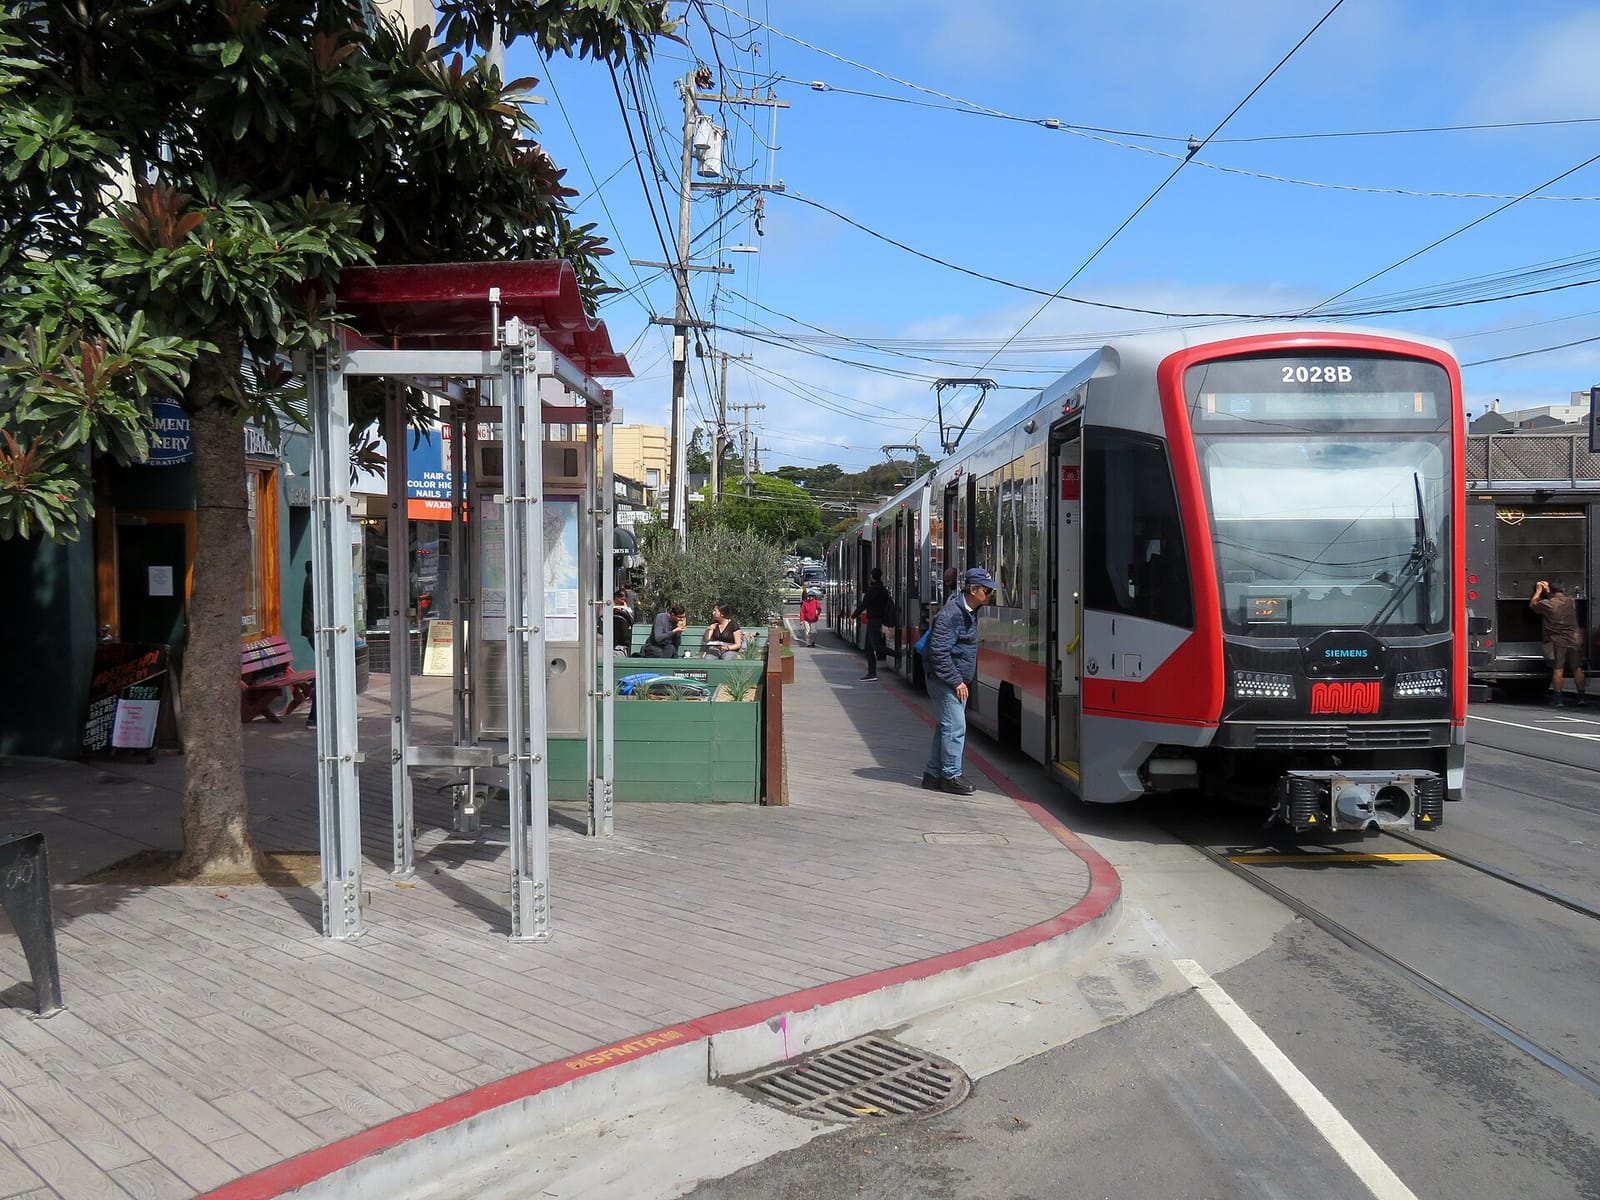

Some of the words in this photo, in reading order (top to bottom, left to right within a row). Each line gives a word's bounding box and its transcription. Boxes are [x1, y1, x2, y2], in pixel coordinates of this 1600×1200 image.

[1281, 365, 1353, 383] 2028B
[424, 472, 444, 480] HAIR
[407, 480, 436, 488] COLOR
[424, 501, 452, 509] WAXIN
[1324, 649, 1368, 658] SIEMENS
[1310, 681, 1382, 715] MUNI
[584, 1037, 668, 1064] SFMTA
